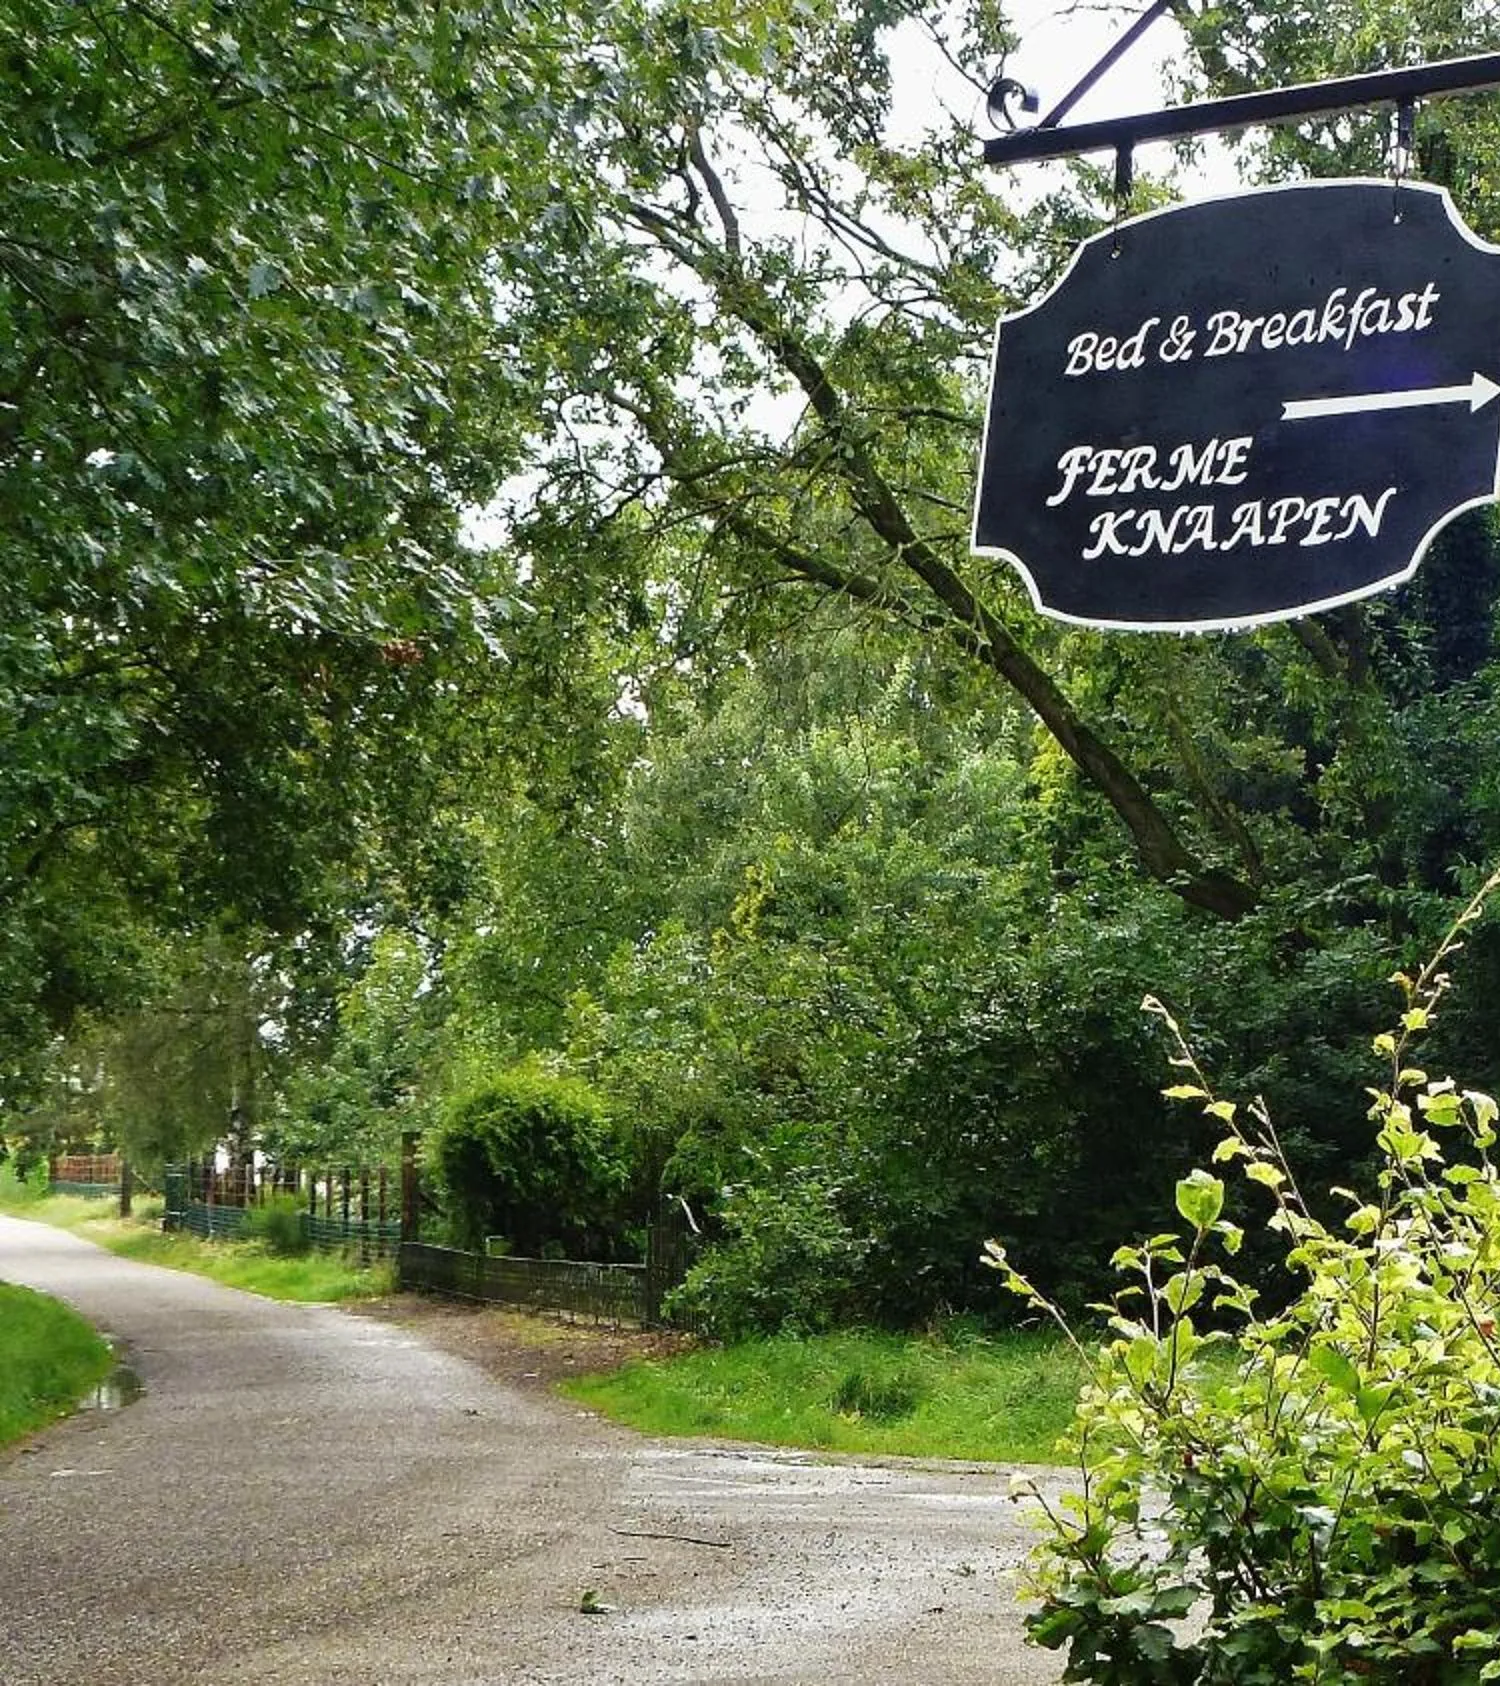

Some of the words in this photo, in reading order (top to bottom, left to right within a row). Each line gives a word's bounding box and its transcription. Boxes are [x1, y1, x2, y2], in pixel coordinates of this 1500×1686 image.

[1065, 316, 1160, 376] Bed
[1159, 315, 1196, 363] &
[1203, 282, 1441, 357] Breakfast
[1046, 437, 1253, 507] FERME
[1082, 488, 1397, 560] KNAAPEN
